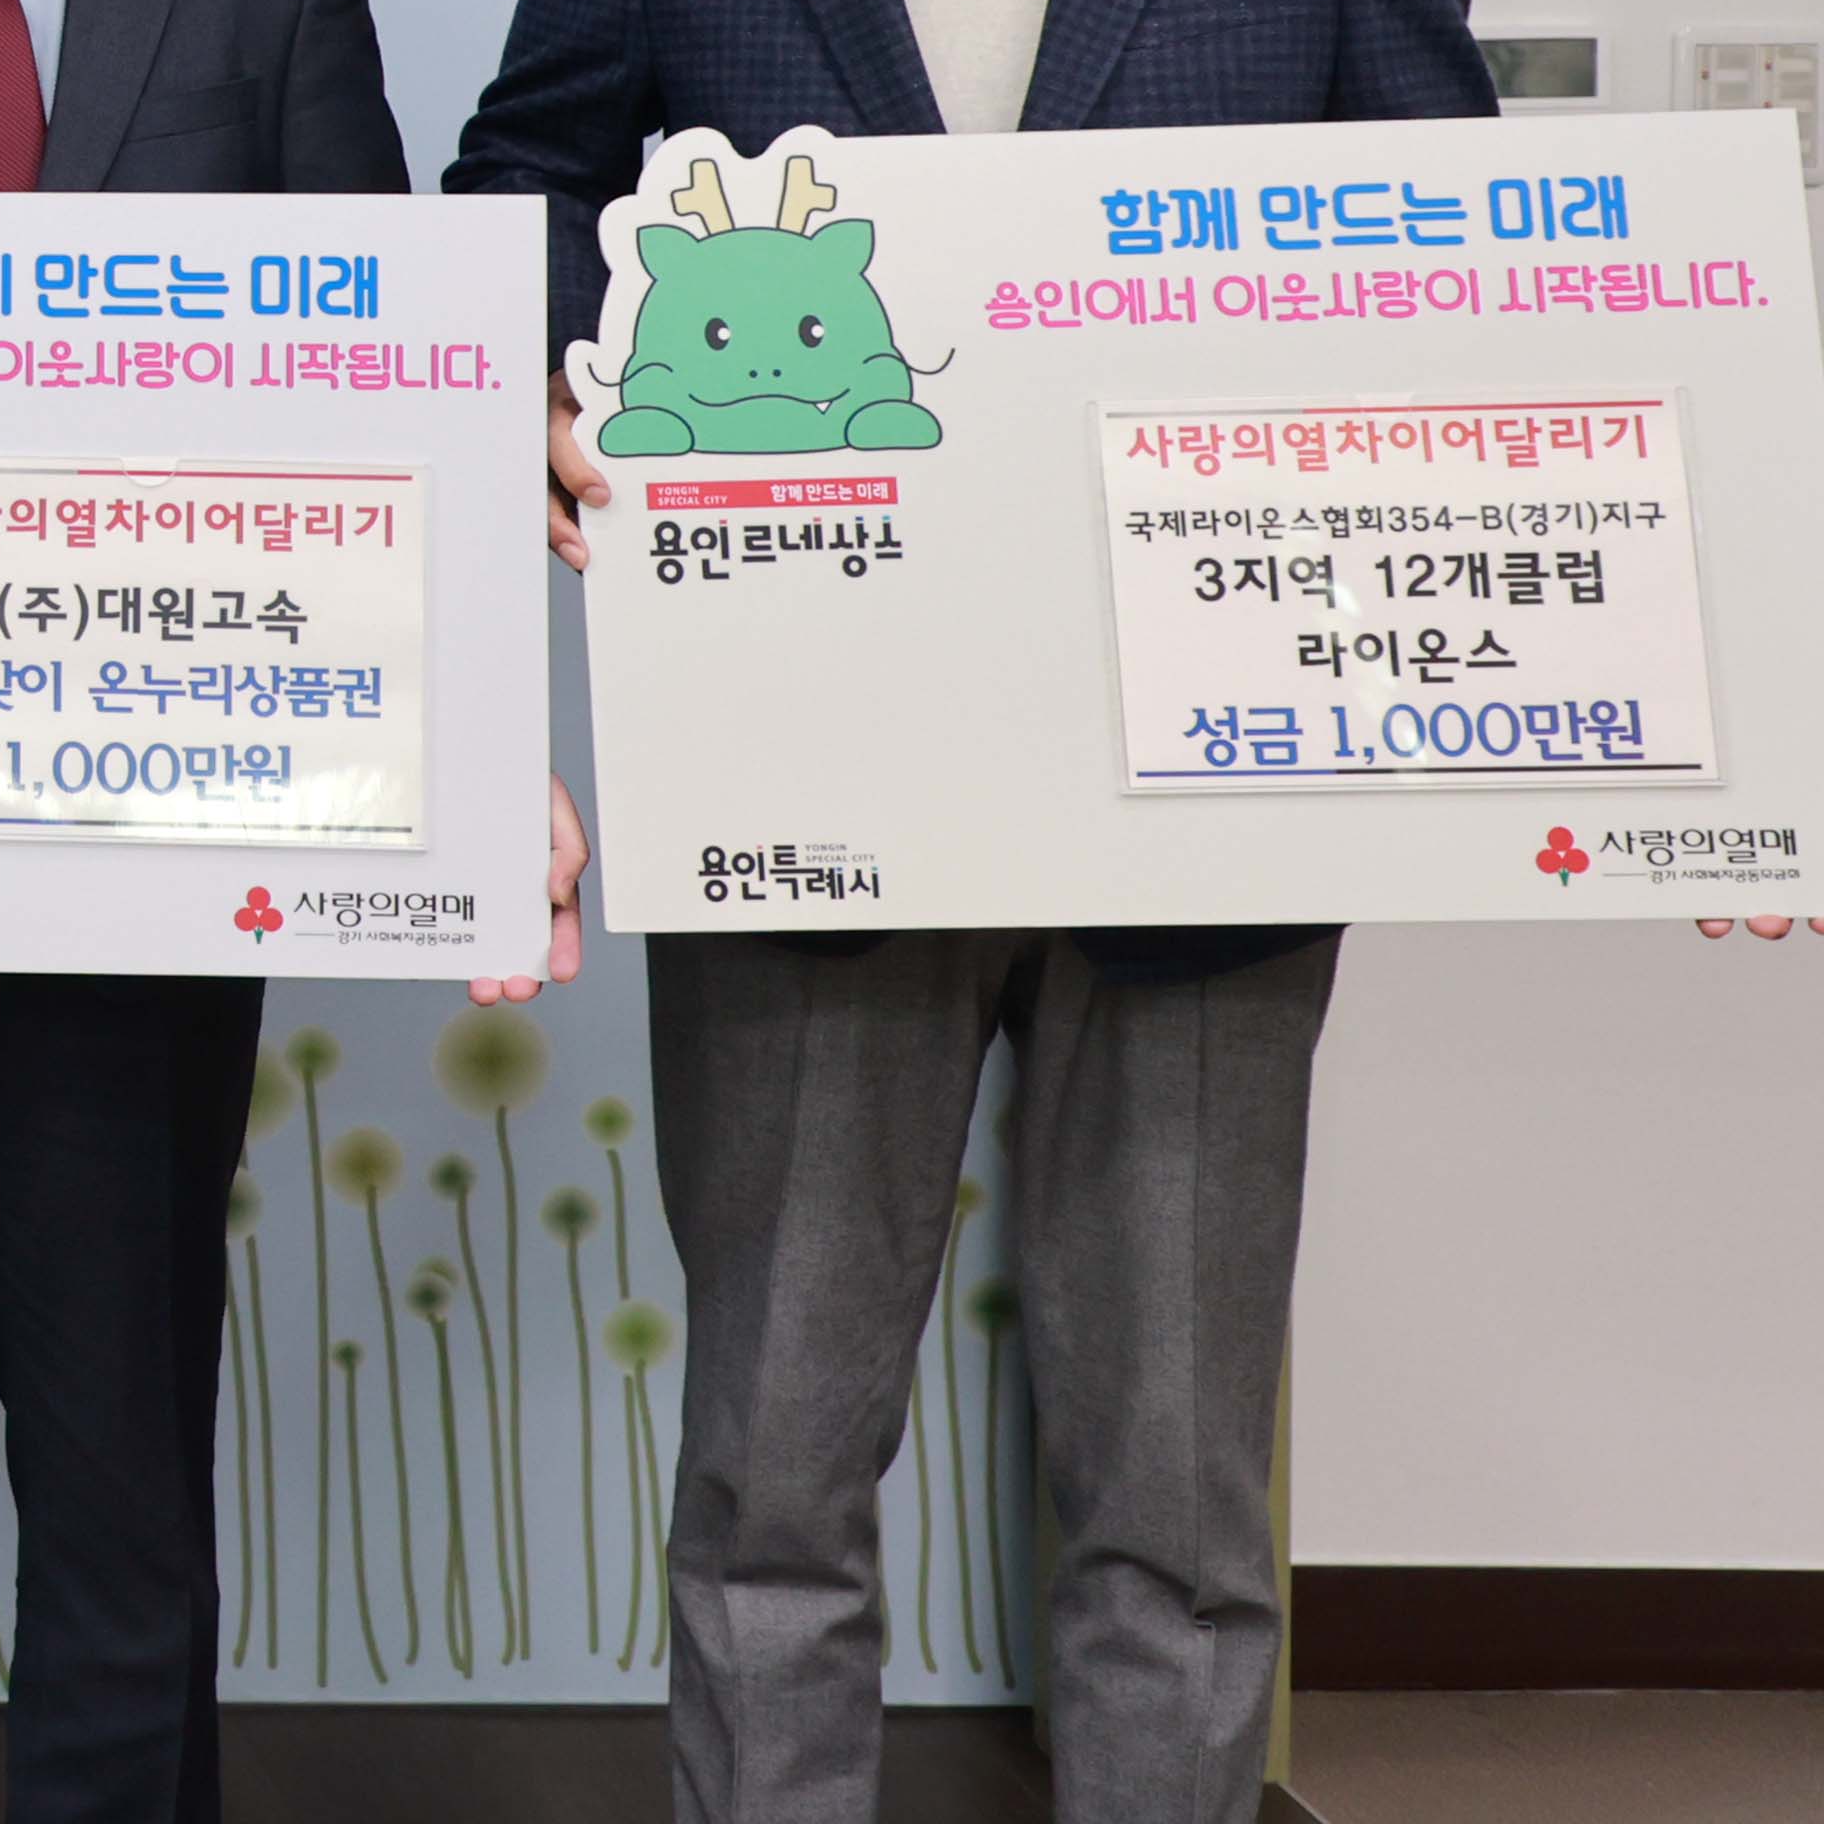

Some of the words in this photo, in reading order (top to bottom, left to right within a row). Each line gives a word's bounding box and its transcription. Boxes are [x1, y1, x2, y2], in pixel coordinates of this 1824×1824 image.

[1100, 188, 1239, 255] 함께
[1259, 182, 1468, 250] 만드는
[1488, 175, 1629, 241] 미래
[35, 254, 229, 319] 만드는
[251, 255, 378, 319] 미래
[985, 277, 1197, 330] 용인에서
[1213, 268, 1481, 321] 이웃사랑이
[1499, 261, 1769, 313] 시작됩니다.
[250, 343, 501, 390] 시작됩니다.
[1128, 414, 1647, 476] 사랑의열차이어달리기
[658, 487, 699, 495] YONGIN
[658, 497, 699, 505] SPECIAL
[704, 496, 727, 504] CITY
[771, 485, 802, 502] 함께
[806, 484, 853, 501] 만드는
[857, 483, 888, 499] 미래
[1124, 499, 1668, 543] 국제라이온스협회354-B(경기)지구
[1192, 553, 1337, 610] 3지역
[1373, 548, 1607, 606] 12개클럽
[1296, 627, 1519, 684] 라이온스
[89, 661, 380, 718] 온누리상품권
[1182, 703, 1305, 768] 성금
[1329, 698, 1646, 766] 1,000만원
[6, 740, 293, 804] 1,000만원
[698, 844, 880, 903] 용인특례시
[1600, 829, 1797, 866] 사랑의열매
[295, 893, 474, 927] 사랑의열매
